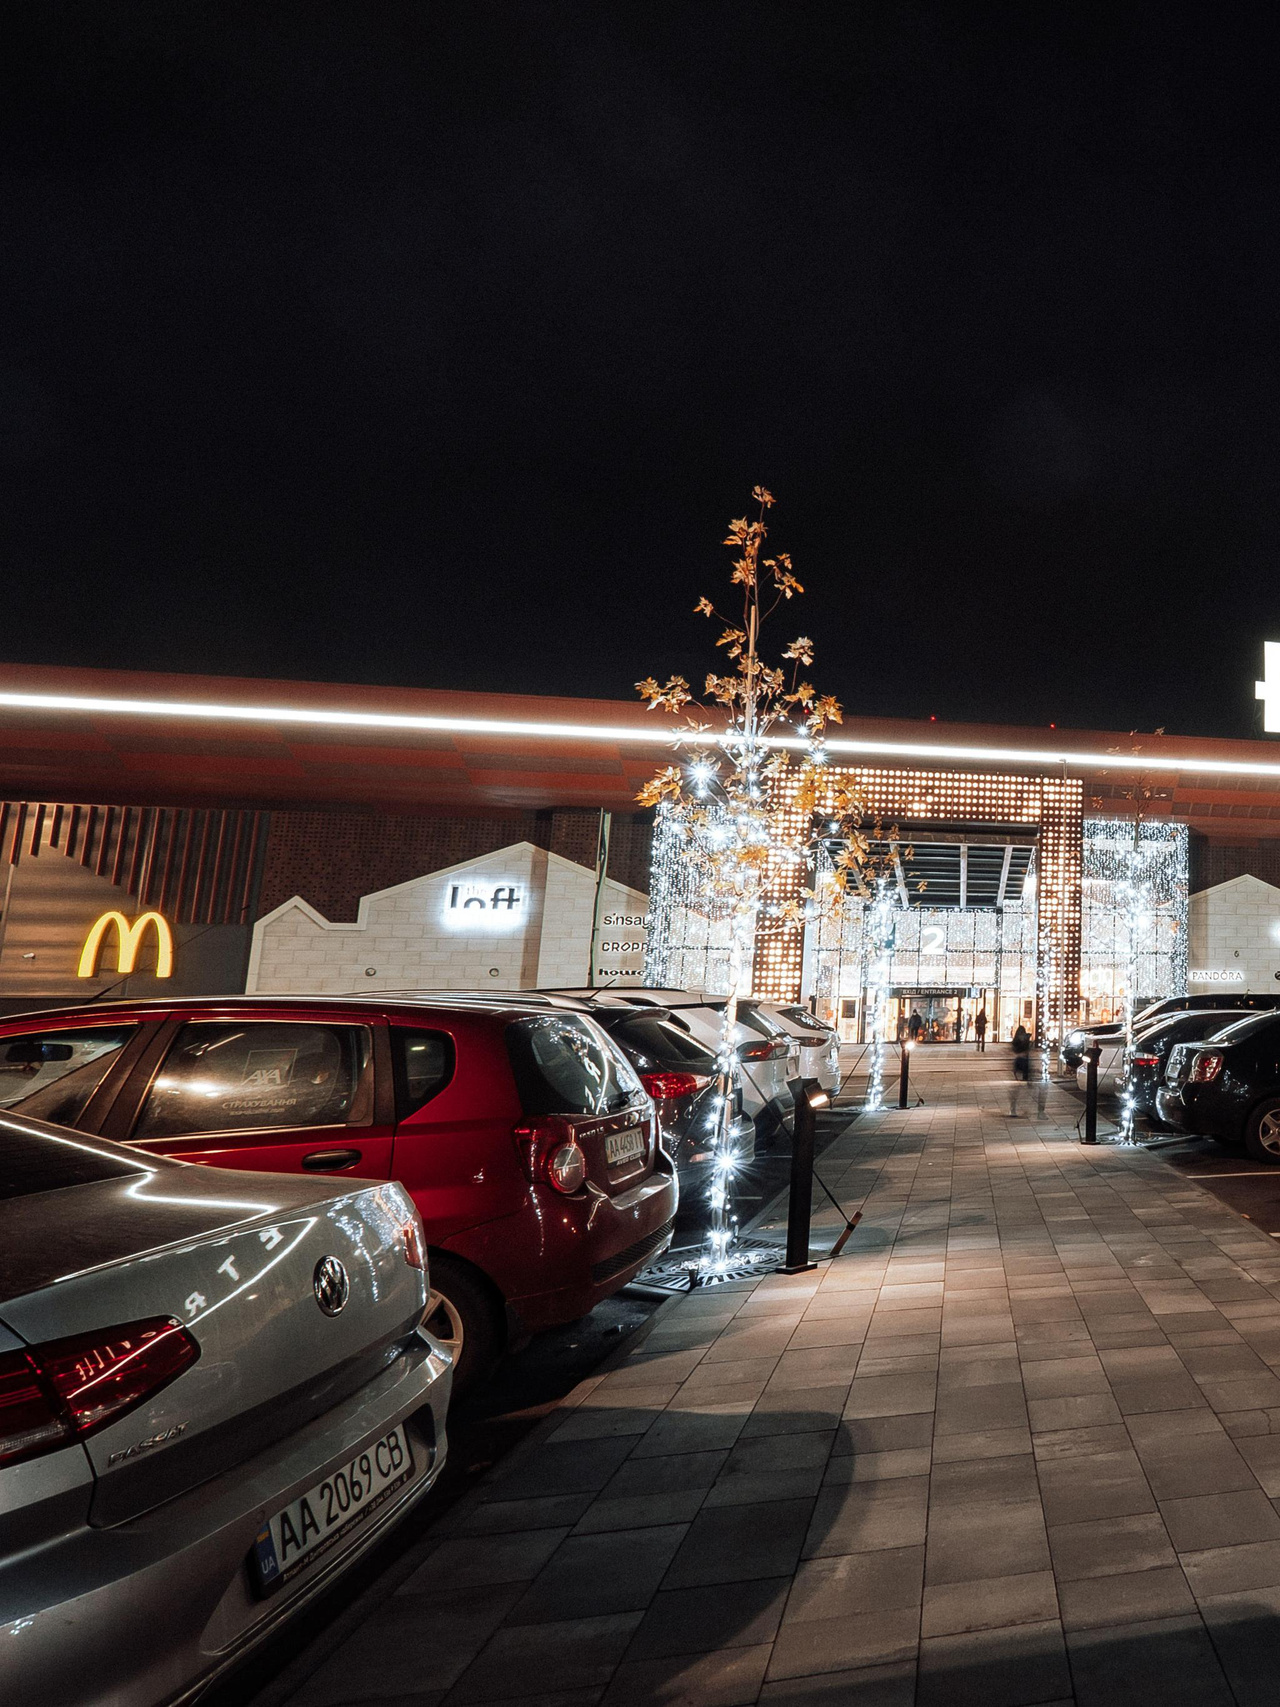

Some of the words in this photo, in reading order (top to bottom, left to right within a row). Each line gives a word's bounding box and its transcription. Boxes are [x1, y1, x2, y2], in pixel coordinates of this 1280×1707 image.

[603, 913, 651, 930] sinsay
[921, 927, 945, 955] 2
[1192, 970, 1243, 981] PANDORA
[279, 1497, 321, 1562] AA
[319, 1453, 372, 1527] 2069
[375, 1430, 404, 1479] CB
[261, 1555, 276, 1574] UA
